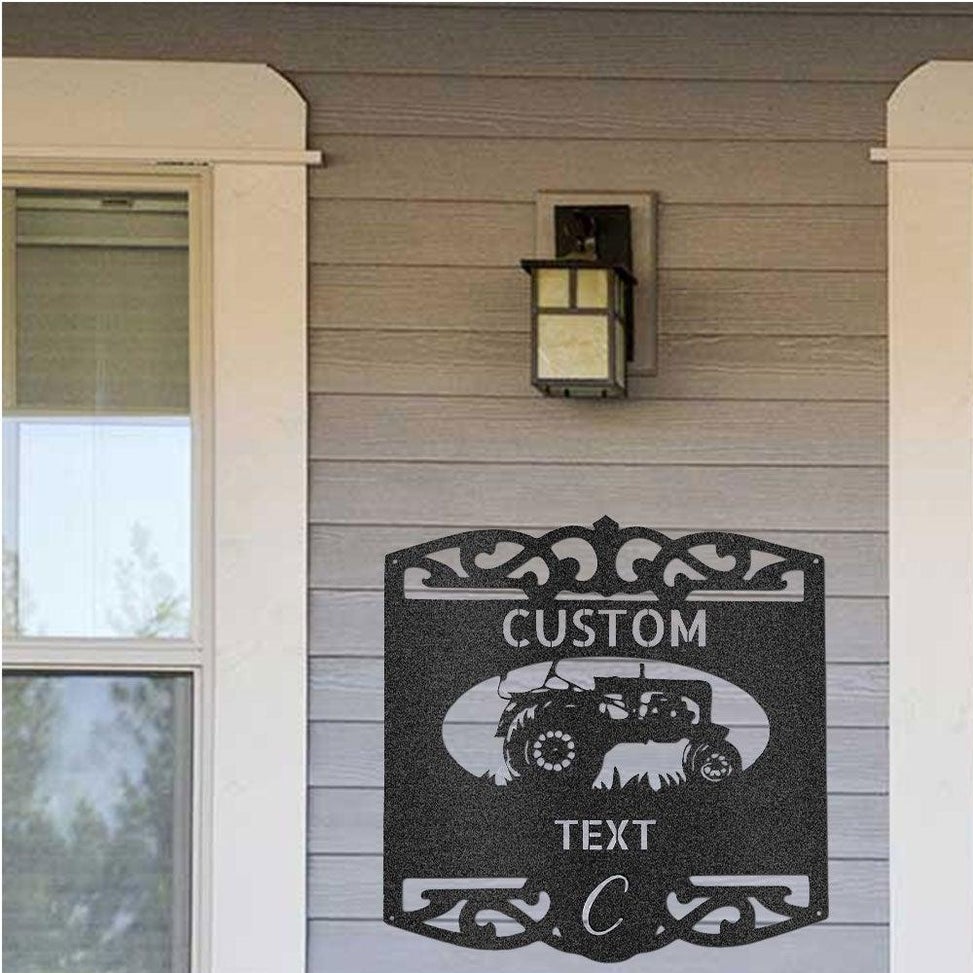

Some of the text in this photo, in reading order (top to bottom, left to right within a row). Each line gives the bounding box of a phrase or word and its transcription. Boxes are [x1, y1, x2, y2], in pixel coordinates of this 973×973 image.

[502, 608, 707, 647] CUSTOM
[554, 819, 657, 851] TEXT
[581, 874, 629, 936] C
